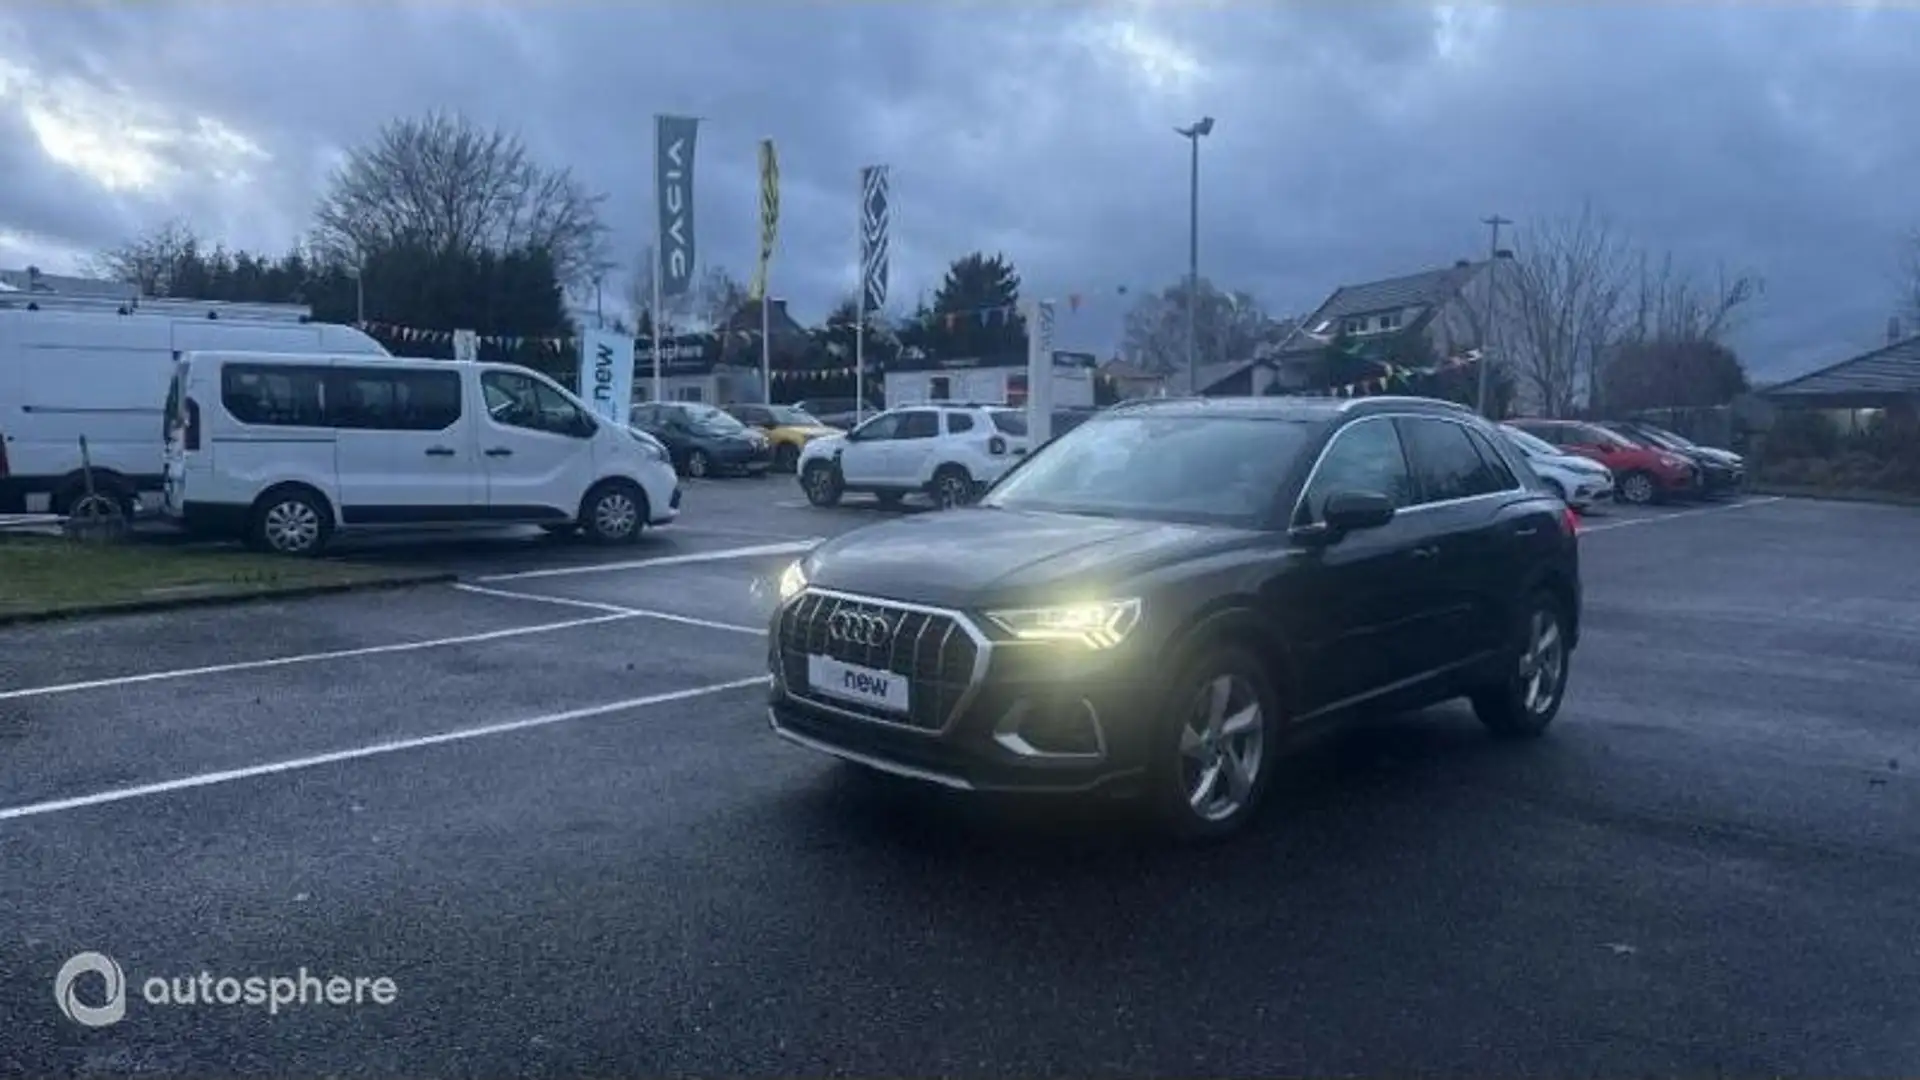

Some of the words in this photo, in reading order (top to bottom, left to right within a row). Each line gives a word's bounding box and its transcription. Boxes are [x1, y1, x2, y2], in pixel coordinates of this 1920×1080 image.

[667, 137, 685, 279] DACIA
[593, 341, 613, 400] new
[844, 669, 888, 697] new
